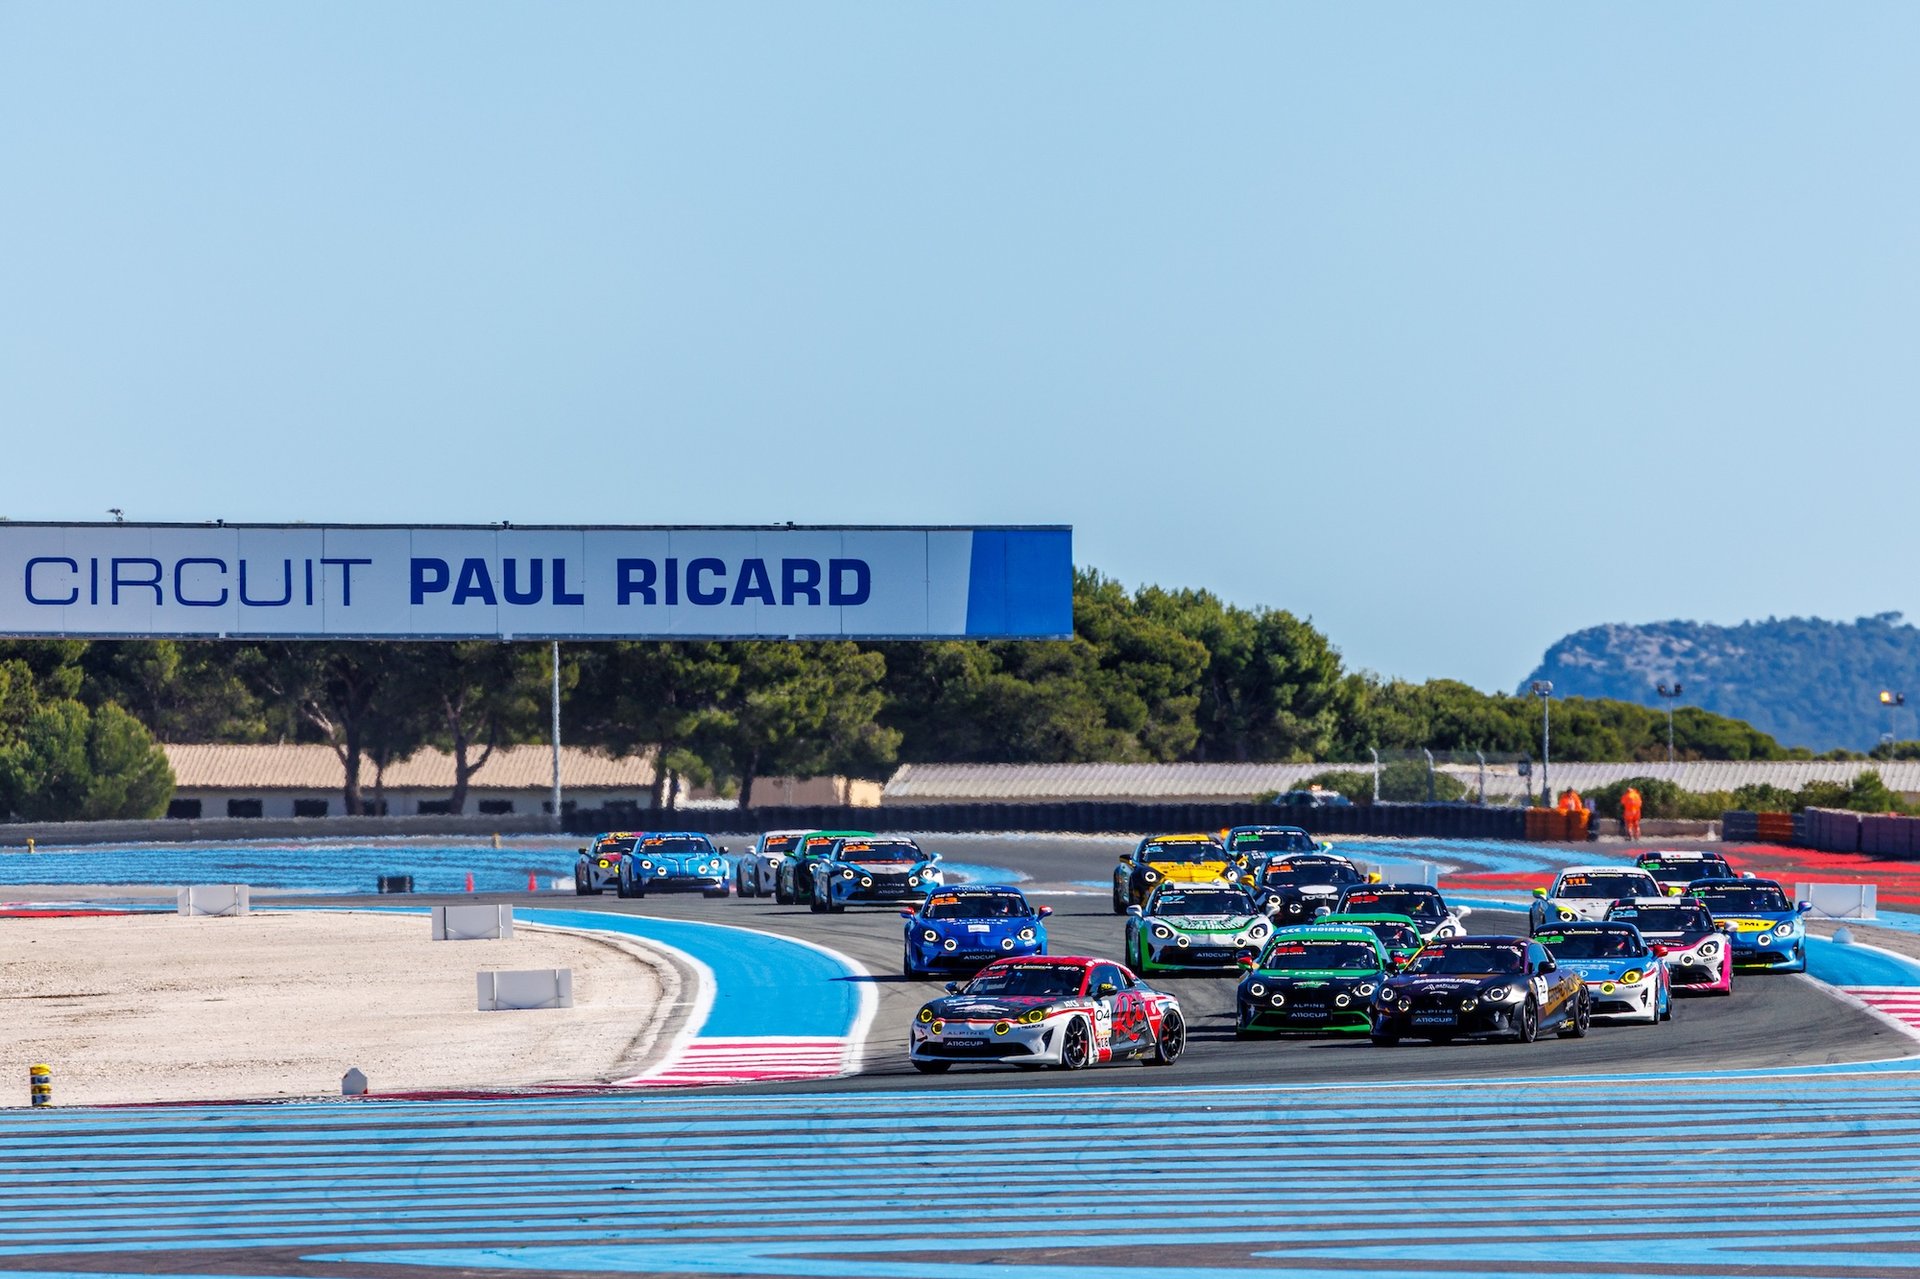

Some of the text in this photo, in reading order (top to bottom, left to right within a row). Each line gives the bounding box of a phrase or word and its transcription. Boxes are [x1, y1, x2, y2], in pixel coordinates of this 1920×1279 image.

[25, 557, 871, 606] CIRCUIT PAUL RICARD
[1095, 1009, 1111, 1022] 04
